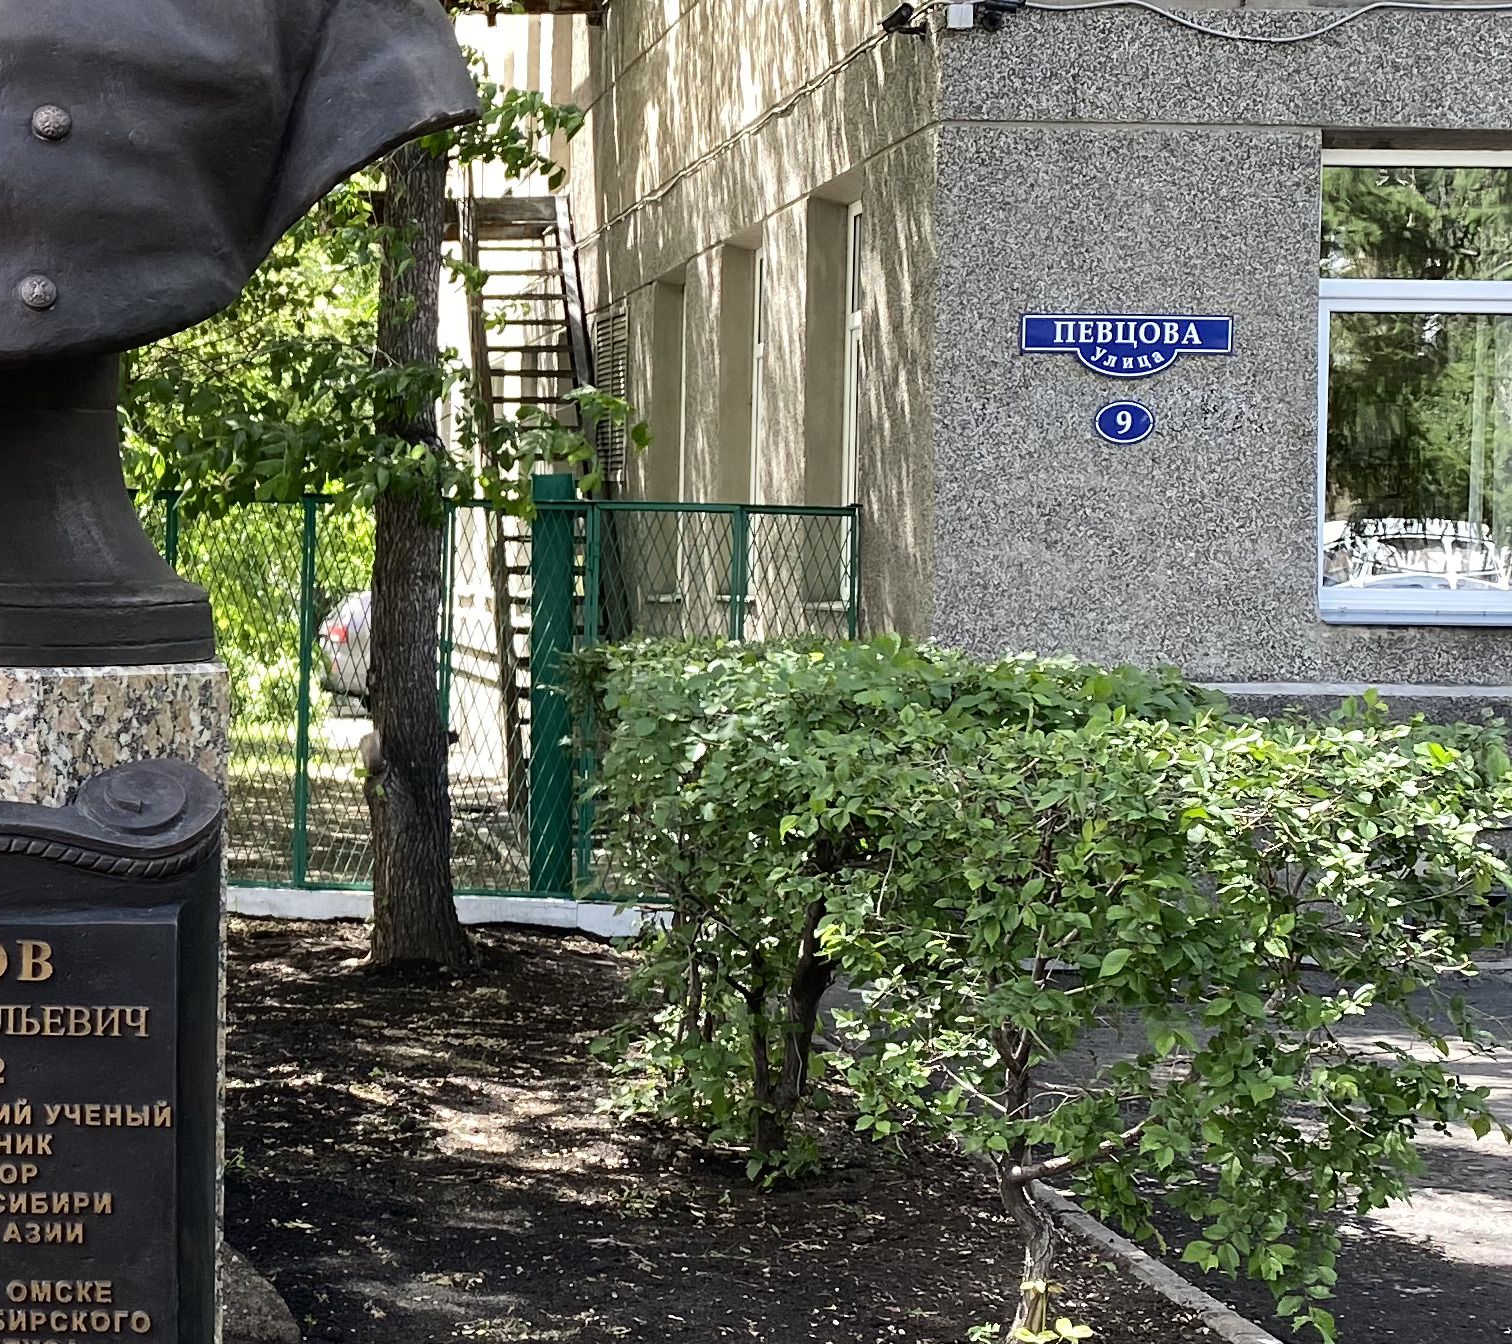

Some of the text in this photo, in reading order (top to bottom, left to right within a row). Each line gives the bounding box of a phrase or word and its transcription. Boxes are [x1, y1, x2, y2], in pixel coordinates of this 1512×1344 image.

[1054, 321, 1202, 348] ПЕВЦОВА
[1117, 411, 1132, 434] 9
[46, 1101, 172, 1129] УЧЕНЫЙ
[3, 1221, 84, 1244] АЗИИ
[7, 1281, 112, 1304] ОМСКЕ
